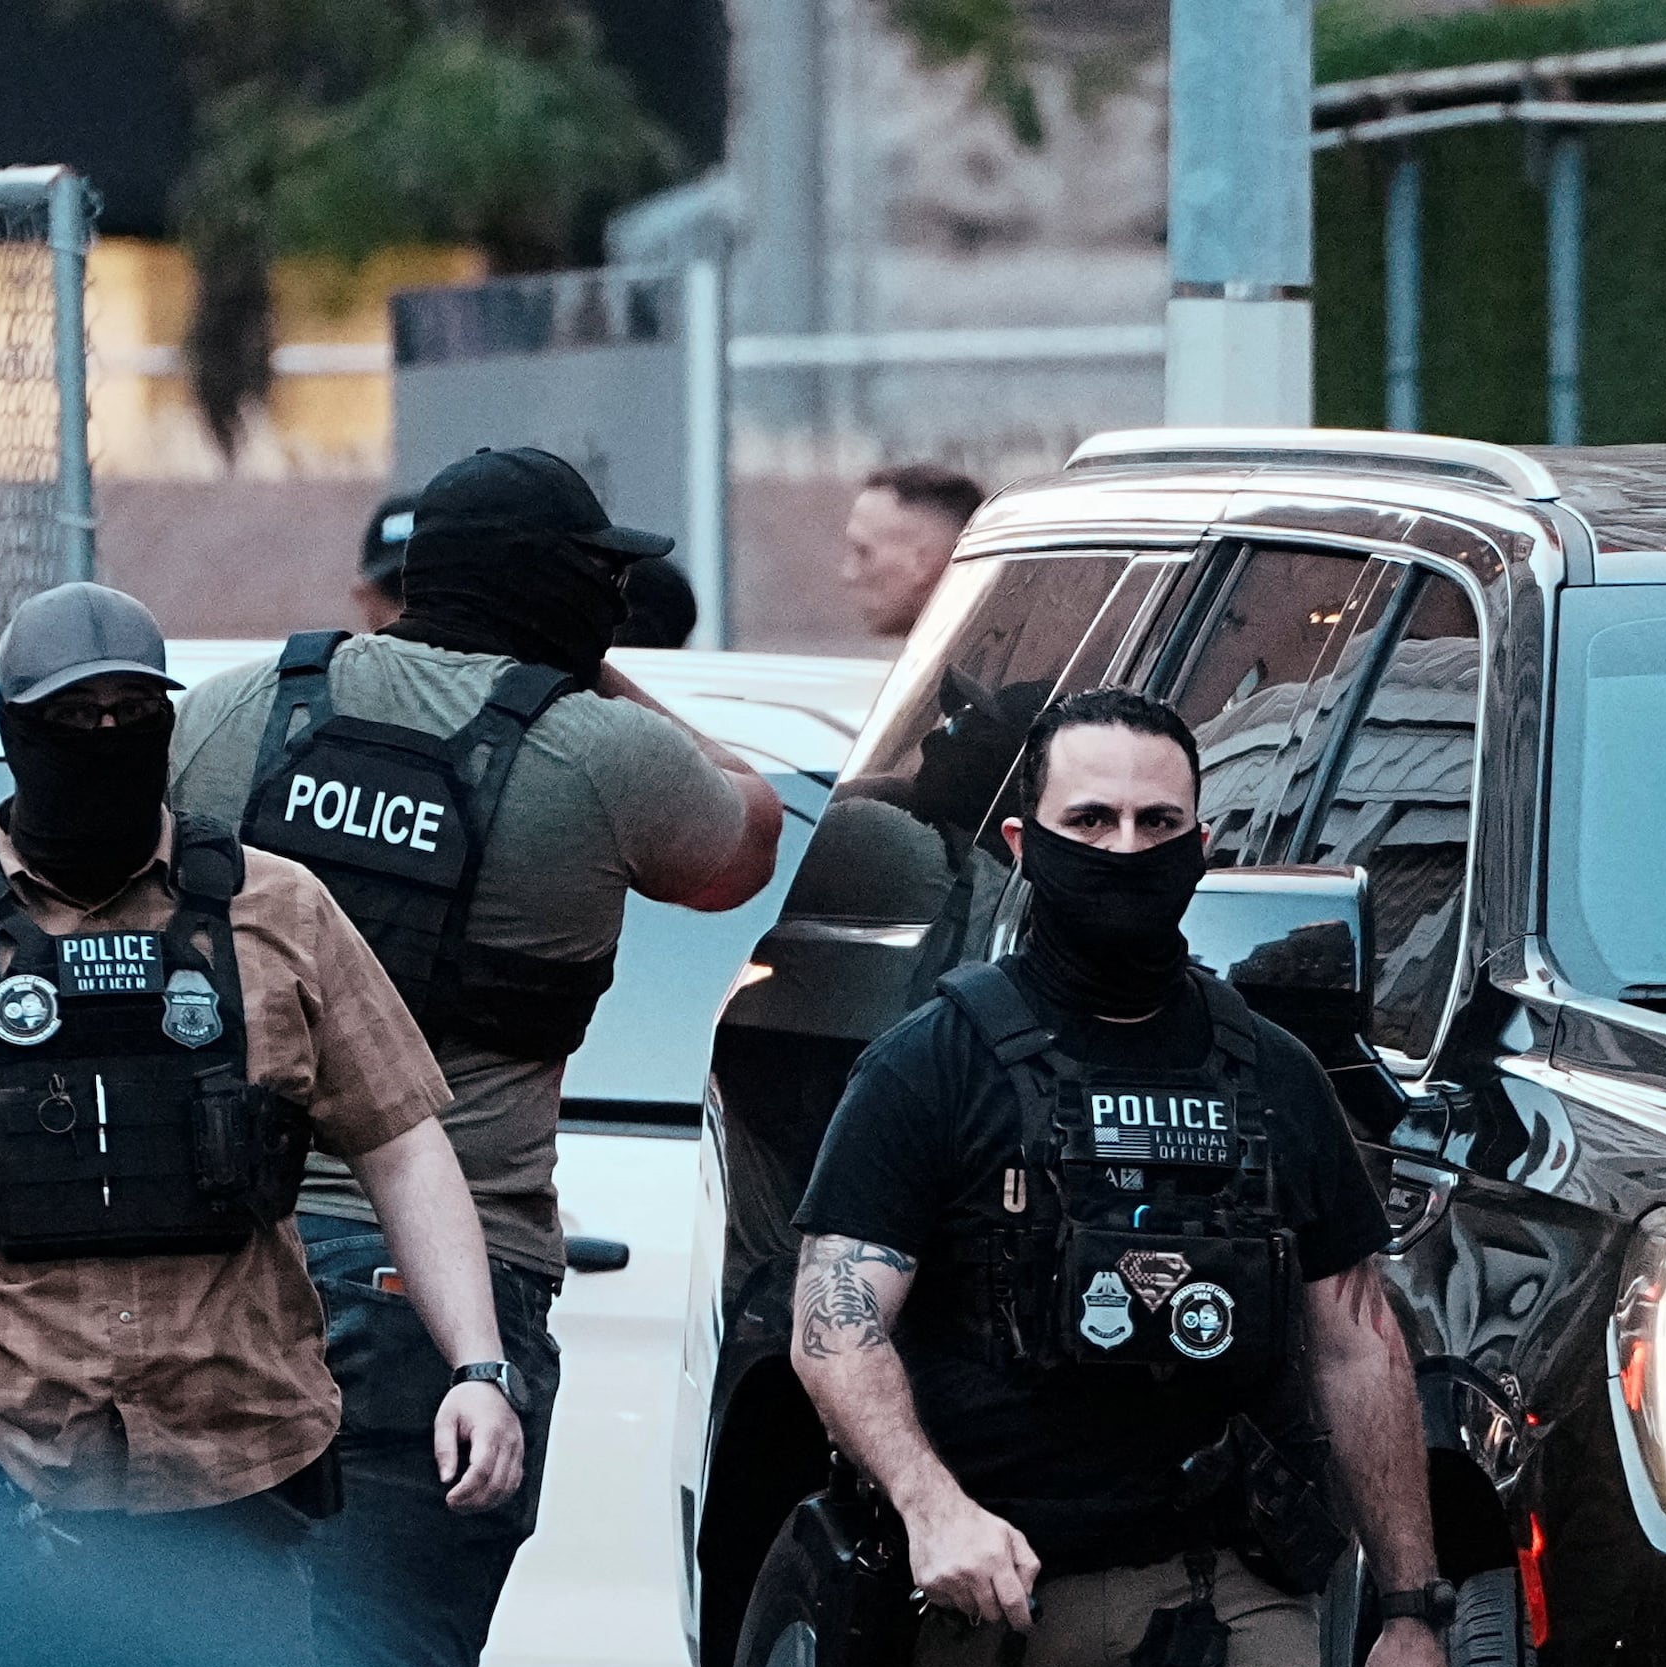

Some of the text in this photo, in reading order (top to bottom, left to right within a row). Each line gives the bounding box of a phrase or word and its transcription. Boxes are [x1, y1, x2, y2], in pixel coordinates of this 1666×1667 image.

[284, 774, 445, 852] POLICE
[62, 935, 157, 963] POLICE
[73, 963, 146, 977] FEDERAL
[77, 977, 147, 991] OFFICER
[1091, 1094, 1229, 1131] POLICE
[1155, 1130, 1229, 1148] FEDERAL
[1159, 1145, 1228, 1163] OFFICER
